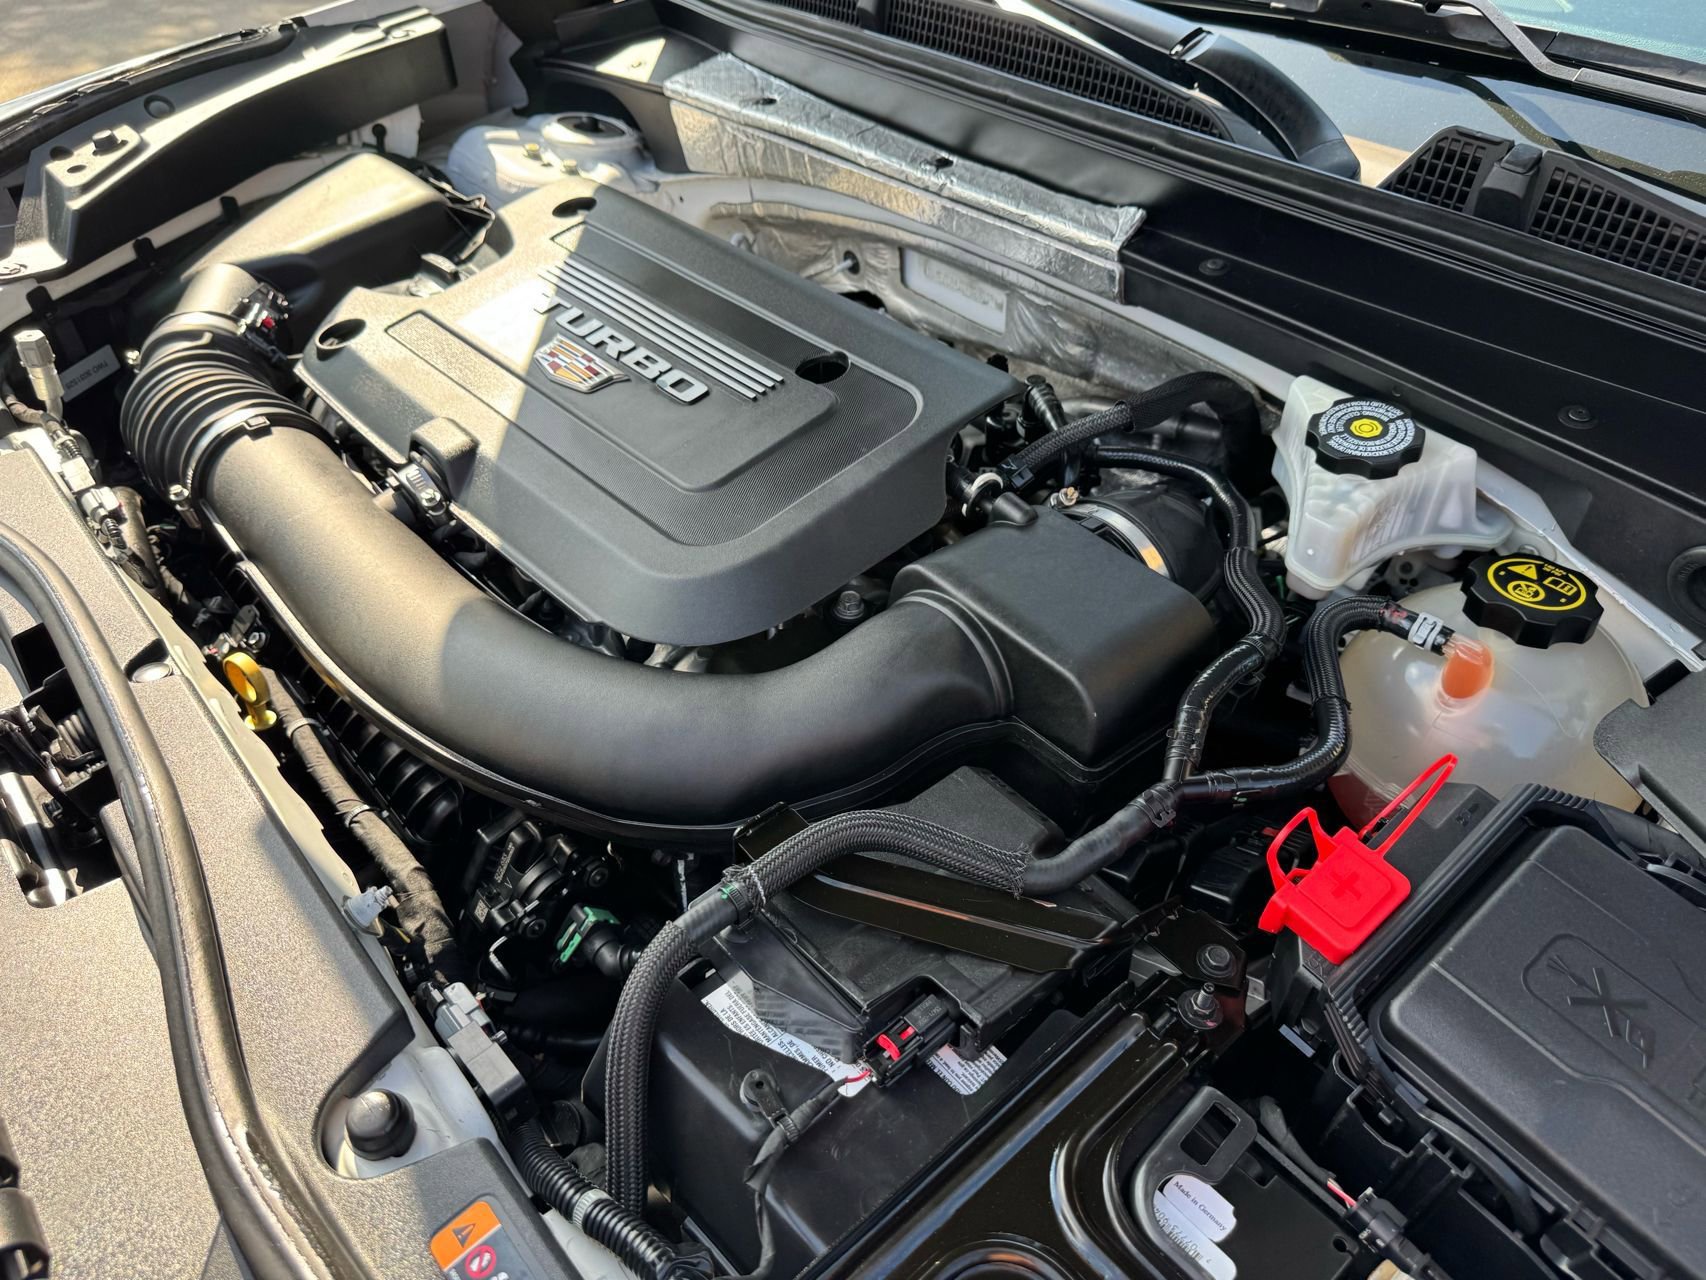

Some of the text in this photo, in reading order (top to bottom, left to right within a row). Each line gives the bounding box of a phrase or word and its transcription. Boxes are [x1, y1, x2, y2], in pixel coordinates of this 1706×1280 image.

[533, 292, 709, 405] TURBO
[724, 990, 734, 1000] DEL
[731, 998, 746, 1014] FUERA
[719, 1007, 727, 1016] LA
[724, 1013, 733, 1022] DE
[825, 1057, 835, 1067] NO
[1172, 1180, 1228, 1233] Made in Germany
